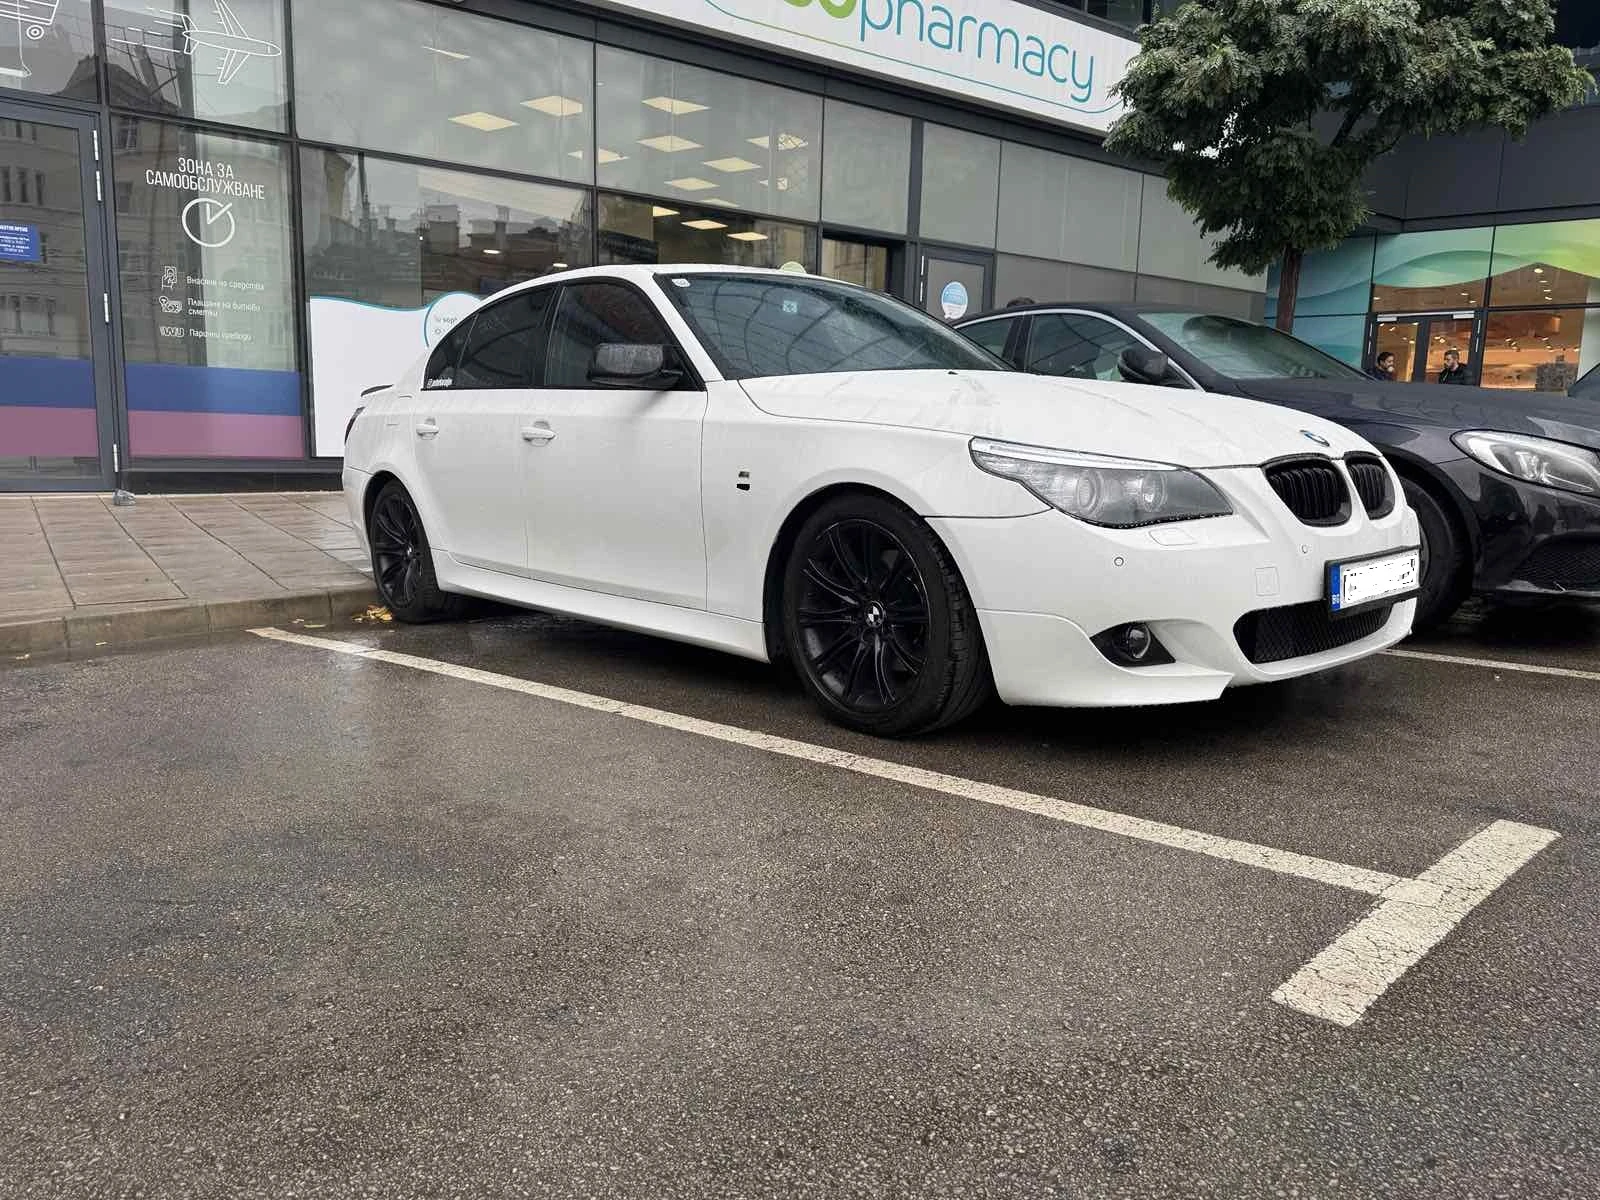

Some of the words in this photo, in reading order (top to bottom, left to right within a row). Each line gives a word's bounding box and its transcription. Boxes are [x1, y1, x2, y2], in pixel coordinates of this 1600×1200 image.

[784, 0, 1094, 103] pharmacy
[178, 157, 213, 176] ЗОНА
[217, 162, 234, 179] ЗА
[145, 169, 265, 200] САМООБСЛУЖВАНЕ
